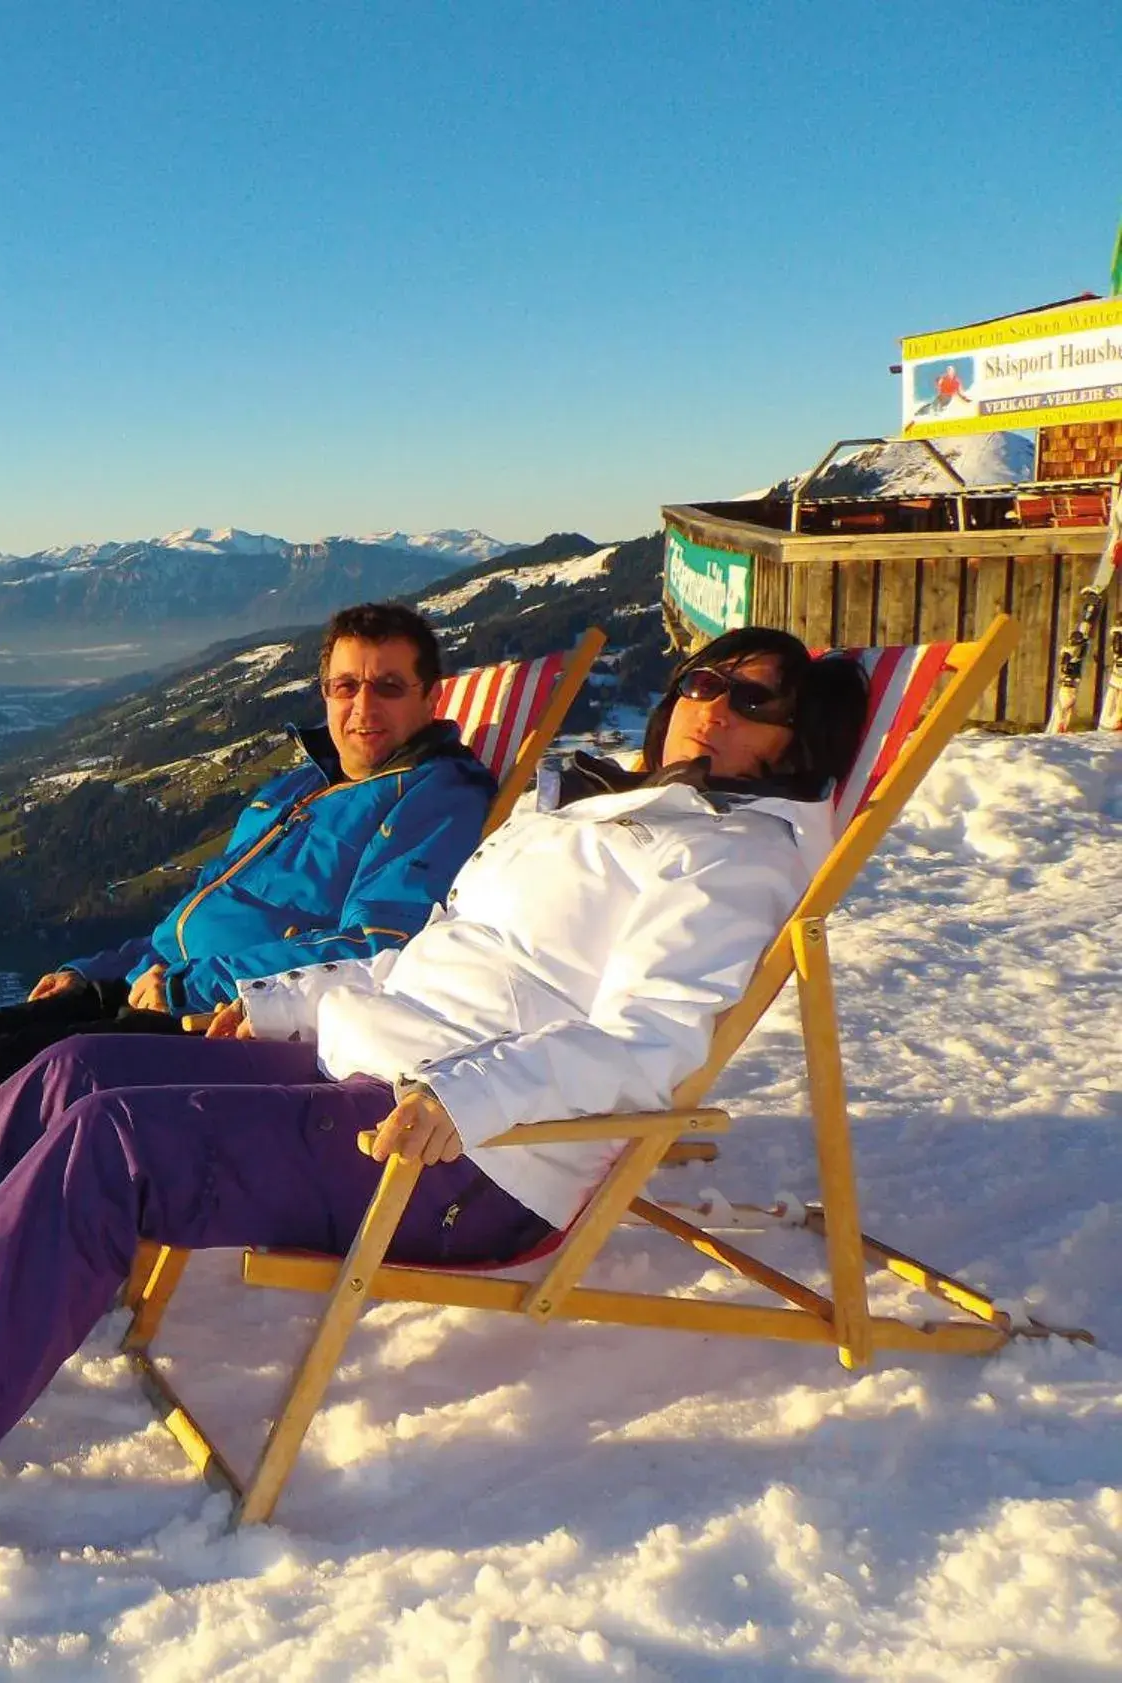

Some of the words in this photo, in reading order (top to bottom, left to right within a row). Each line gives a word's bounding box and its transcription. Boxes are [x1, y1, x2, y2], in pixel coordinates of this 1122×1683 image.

[933, 335, 984, 353] Partner
[1009, 320, 1060, 338] Sachen
[985, 350, 1053, 380] Skisport
[986, 396, 1040, 413] VERKAUF
